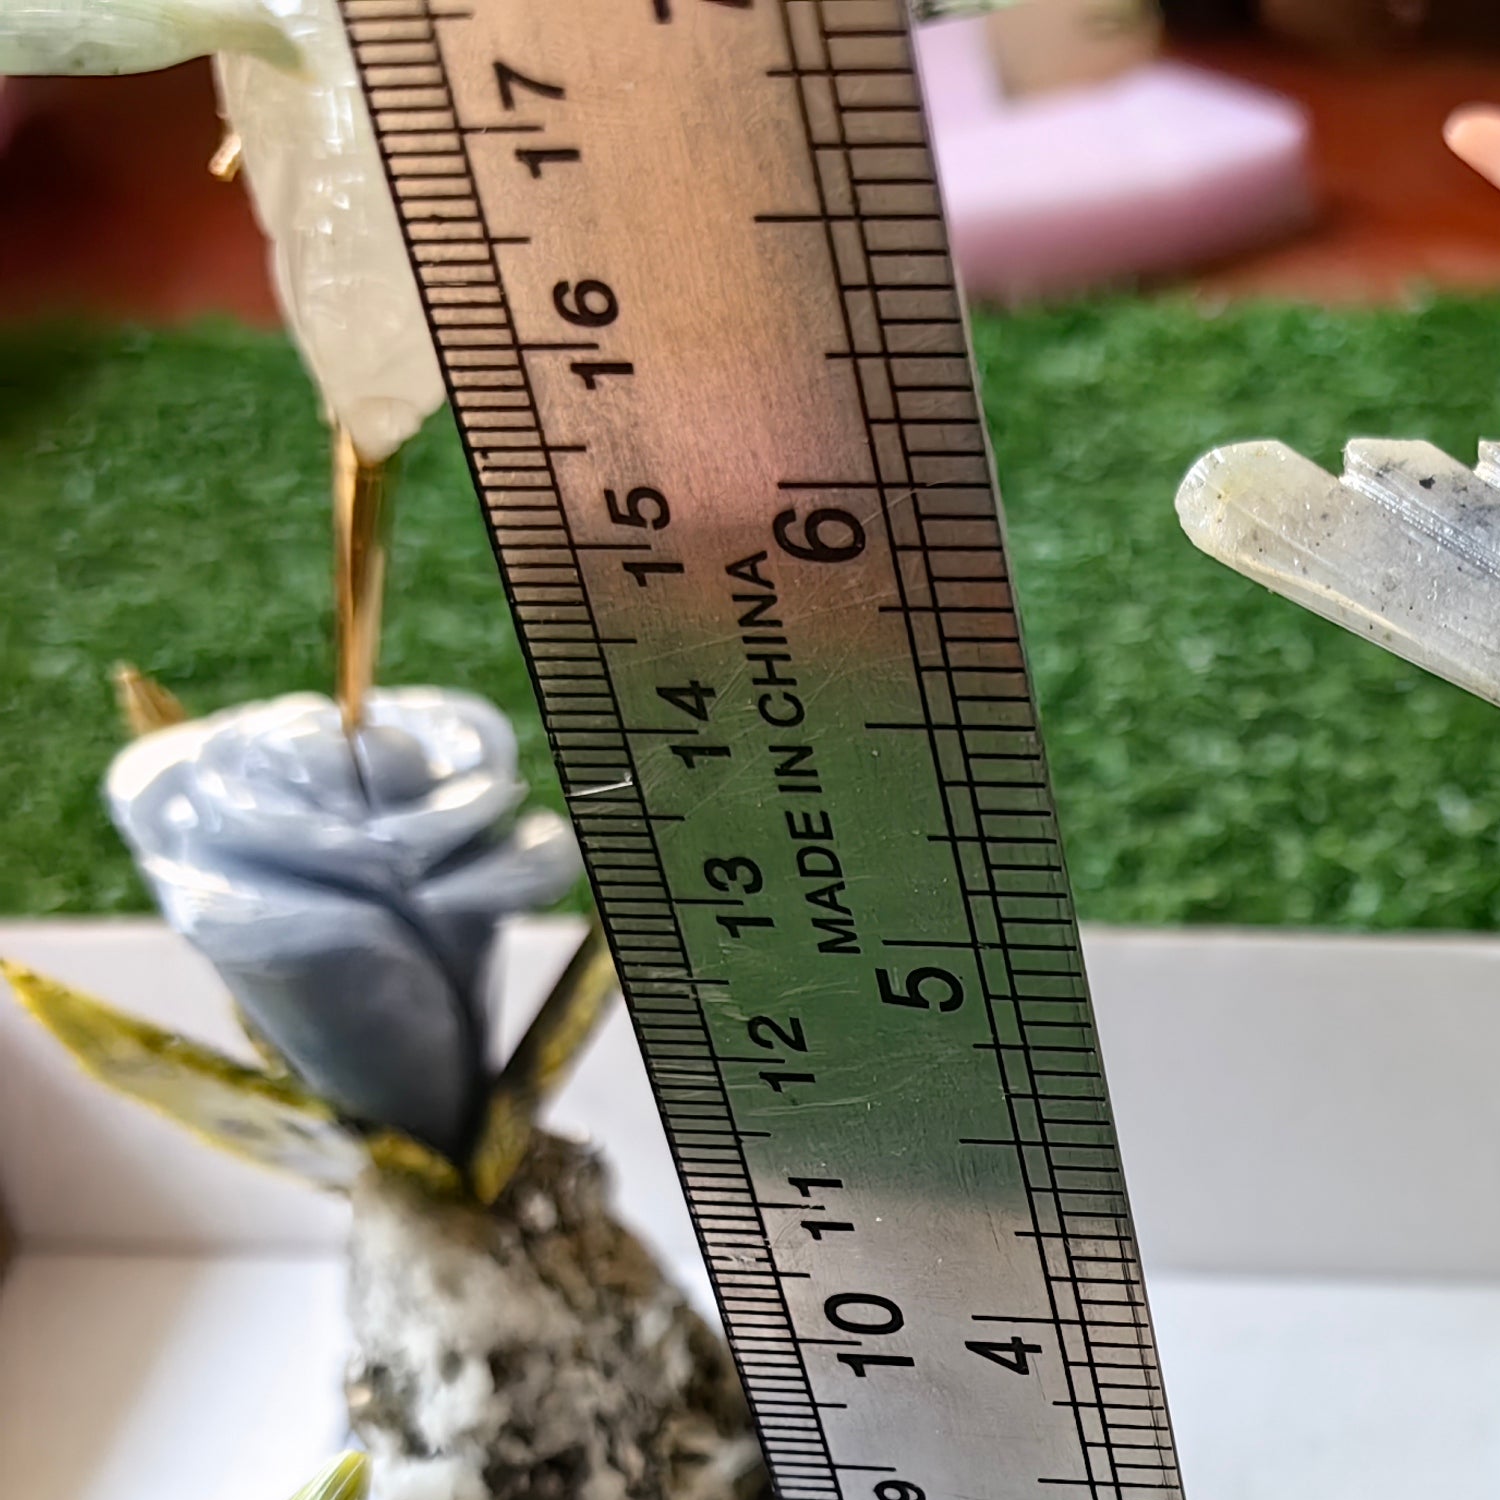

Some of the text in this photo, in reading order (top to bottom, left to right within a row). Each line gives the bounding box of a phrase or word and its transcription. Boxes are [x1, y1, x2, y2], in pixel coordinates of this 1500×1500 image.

[493, 61, 580, 179] 17
[553, 278, 633, 390] 16
[603, 485, 684, 587] 15
[771, 507, 866, 564] 6
[656, 680, 731, 770] 14
[726, 550, 863, 954] MADE IN CHINA
[703, 856, 776, 938] 13
[875, 966, 964, 1013] 5
[747, 1015, 816, 1093] 12
[788, 1176, 854, 1240] 11
[823, 1292, 915, 1377] 10
[965, 1337, 1042, 1375] 4
